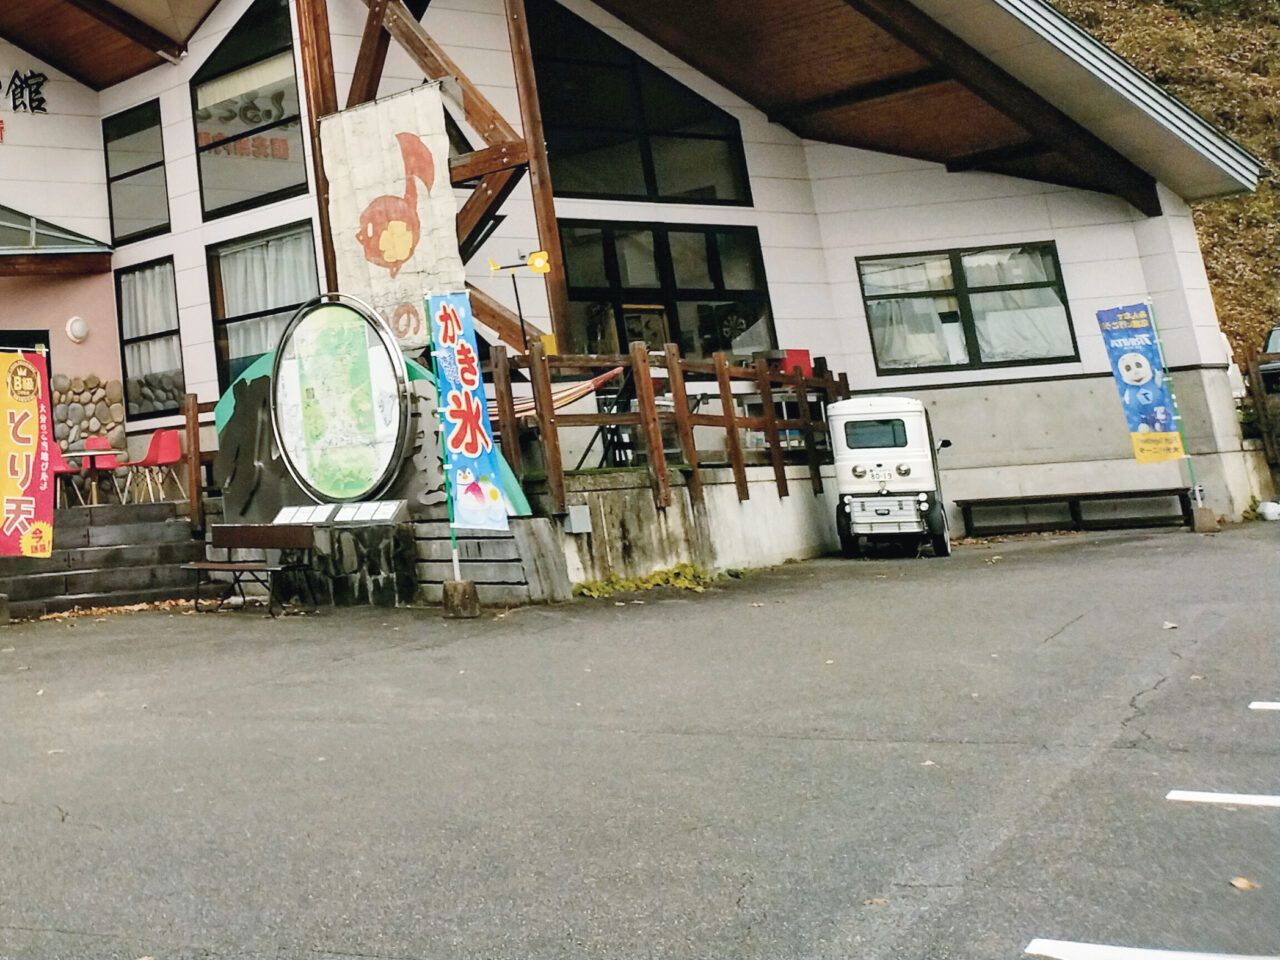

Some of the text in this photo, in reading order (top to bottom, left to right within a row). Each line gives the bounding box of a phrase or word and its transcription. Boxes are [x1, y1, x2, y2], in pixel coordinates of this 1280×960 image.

[436, 302, 490, 457] かき氷
[4, 409, 35, 536] とり天
